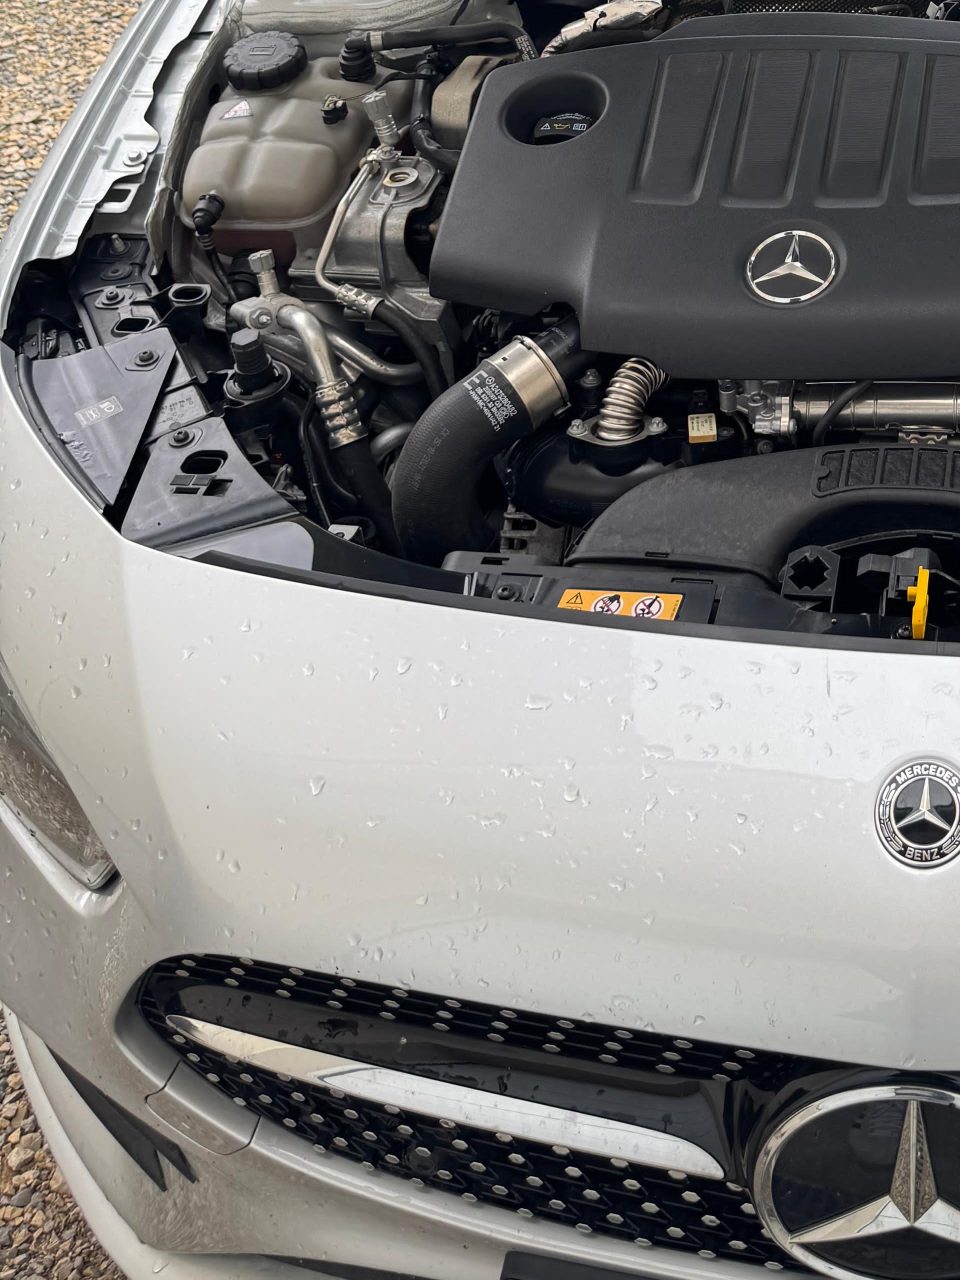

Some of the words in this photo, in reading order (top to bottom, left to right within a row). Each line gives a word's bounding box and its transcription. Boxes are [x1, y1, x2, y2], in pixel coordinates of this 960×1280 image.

[463, 370, 488, 390] E
[895, 764, 959, 788] MERCEDES
[905, 847, 941, 861] BENZ
